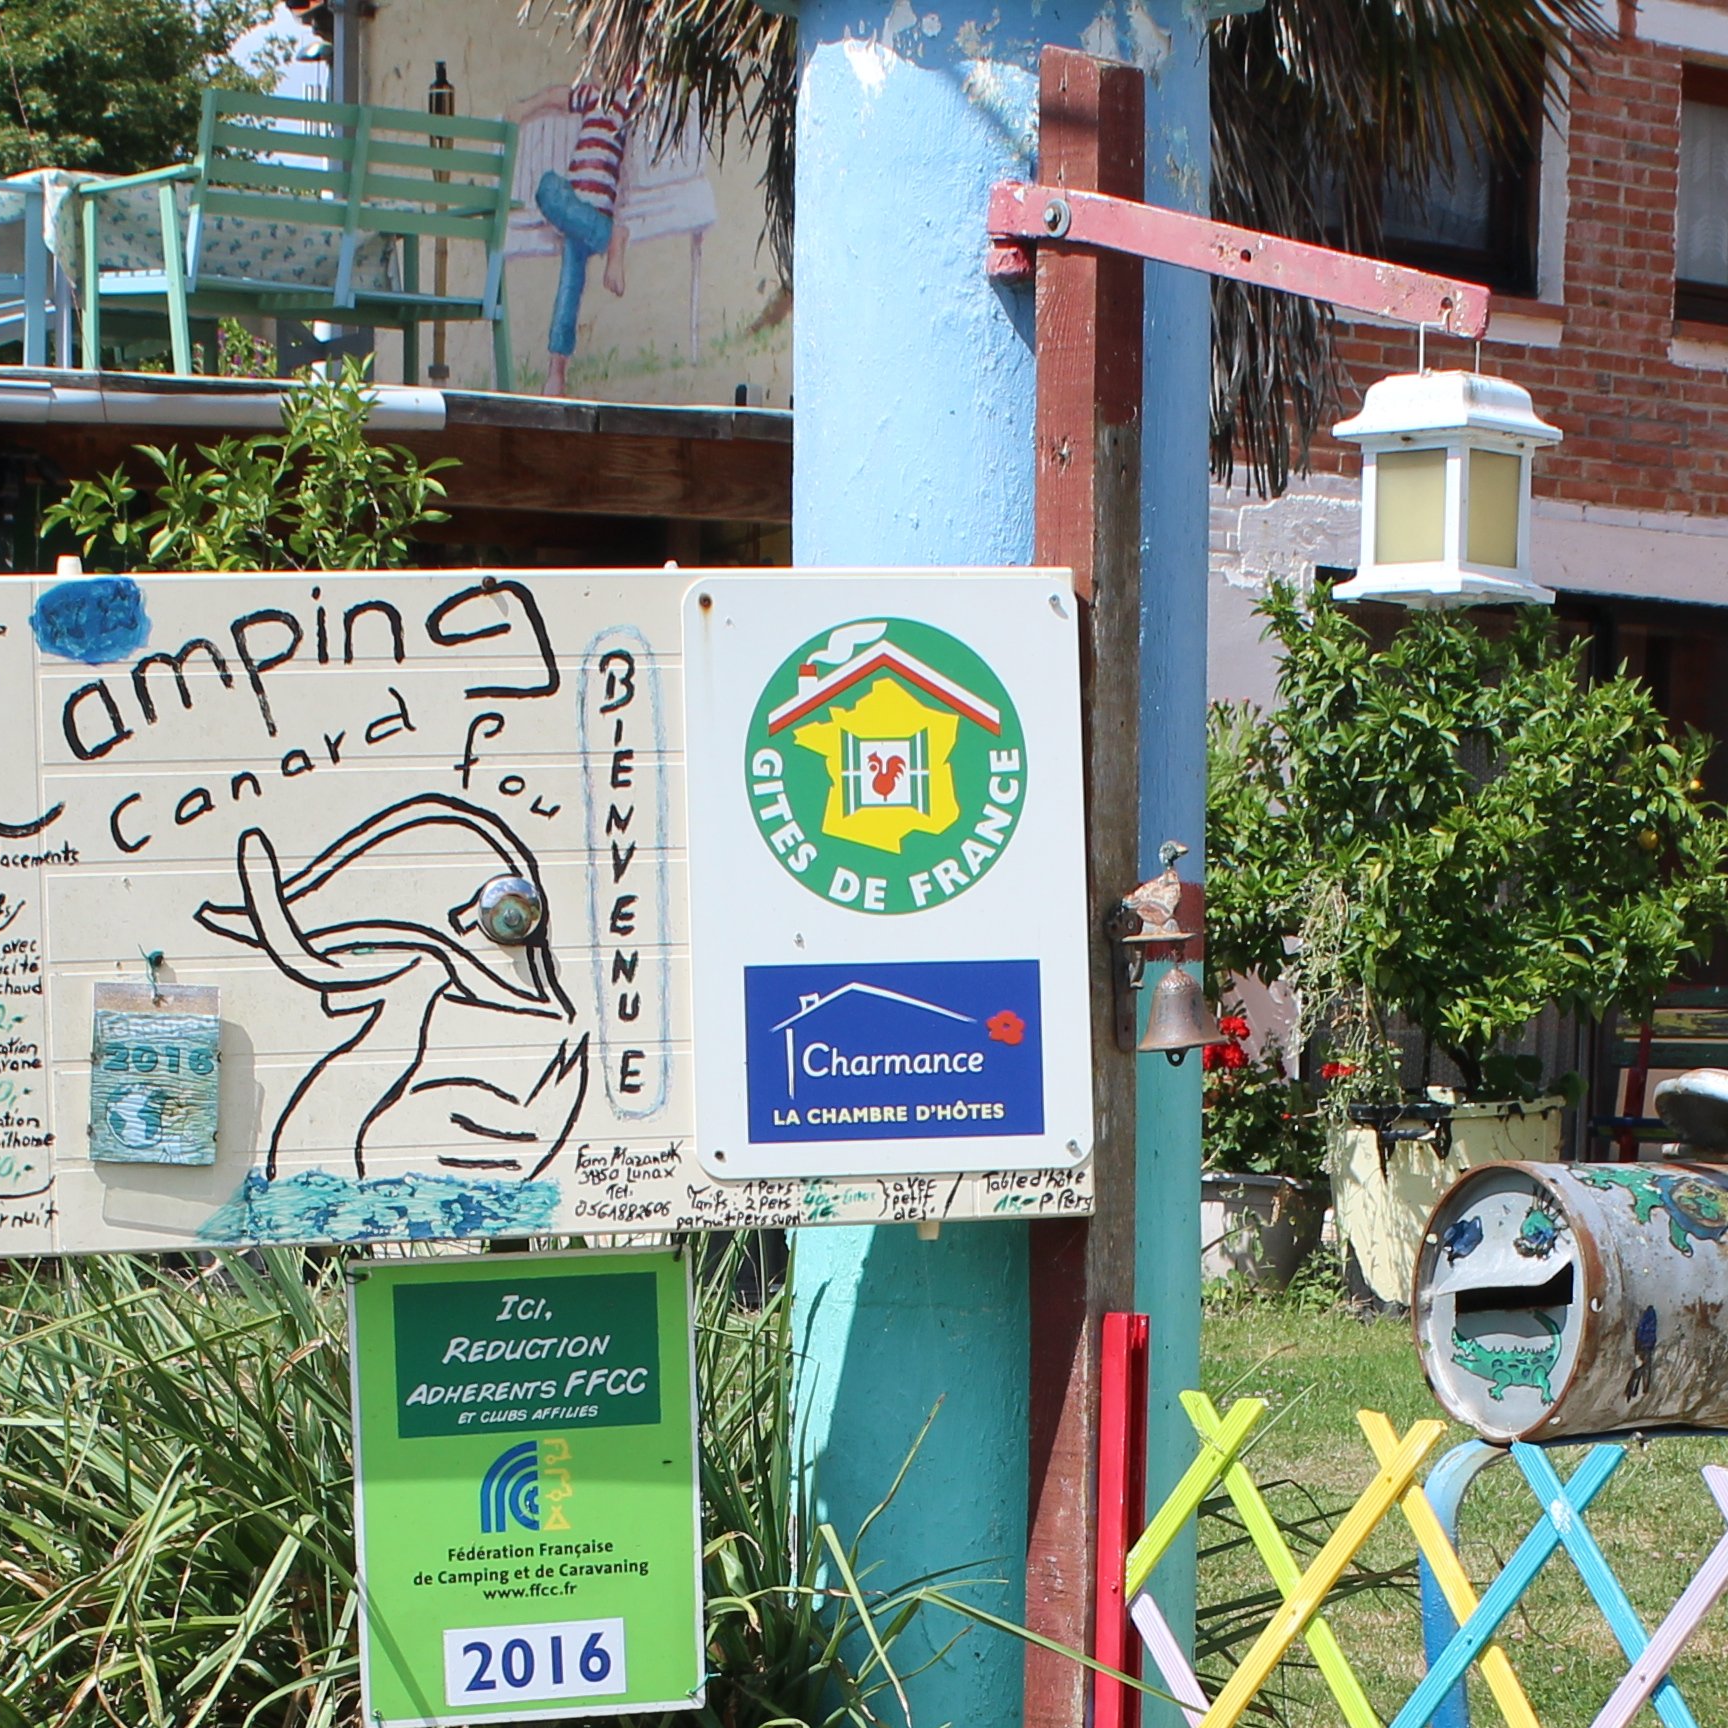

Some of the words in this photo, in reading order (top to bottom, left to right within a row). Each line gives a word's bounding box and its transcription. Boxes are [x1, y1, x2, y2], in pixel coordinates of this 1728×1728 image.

[454, 712, 561, 821] fou
[752, 747, 818, 874] GITES
[829, 866, 888, 912] DE
[908, 747, 1021, 908] FRANCE
[598, 648, 646, 1095] BIENVENUE
[102, 1044, 215, 1076] 2016
[802, 1043, 986, 1078] Charmance
[773, 1108, 801, 1127] LA
[806, 1105, 909, 1124] CHAMBRE
[915, 1100, 1006, 1122] D'HÔTES
[626, 1165, 677, 1183] Lunax
[745, 1197, 756, 1211] 2
[442, 1334, 611, 1364] REDUCTION
[406, 1380, 558, 1406] ADHERENTS
[563, 1367, 648, 1398] FFCC
[457, 1411, 476, 1425] ET
[480, 1408, 528, 1423] CLUBS
[532, 1404, 599, 1420] AFFILIES
[448, 1544, 535, 1562] Fédération
[539, 1539, 614, 1559] Française
[413, 1571, 435, 1586] de
[438, 1568, 509, 1587] Camping
[514, 1565, 531, 1579] et
[535, 1563, 555, 1579] de
[559, 1558, 649, 1579] Caravaning
[482, 1582, 577, 1601] www.ffcc.fr
[462, 1631, 611, 1692] 2016
